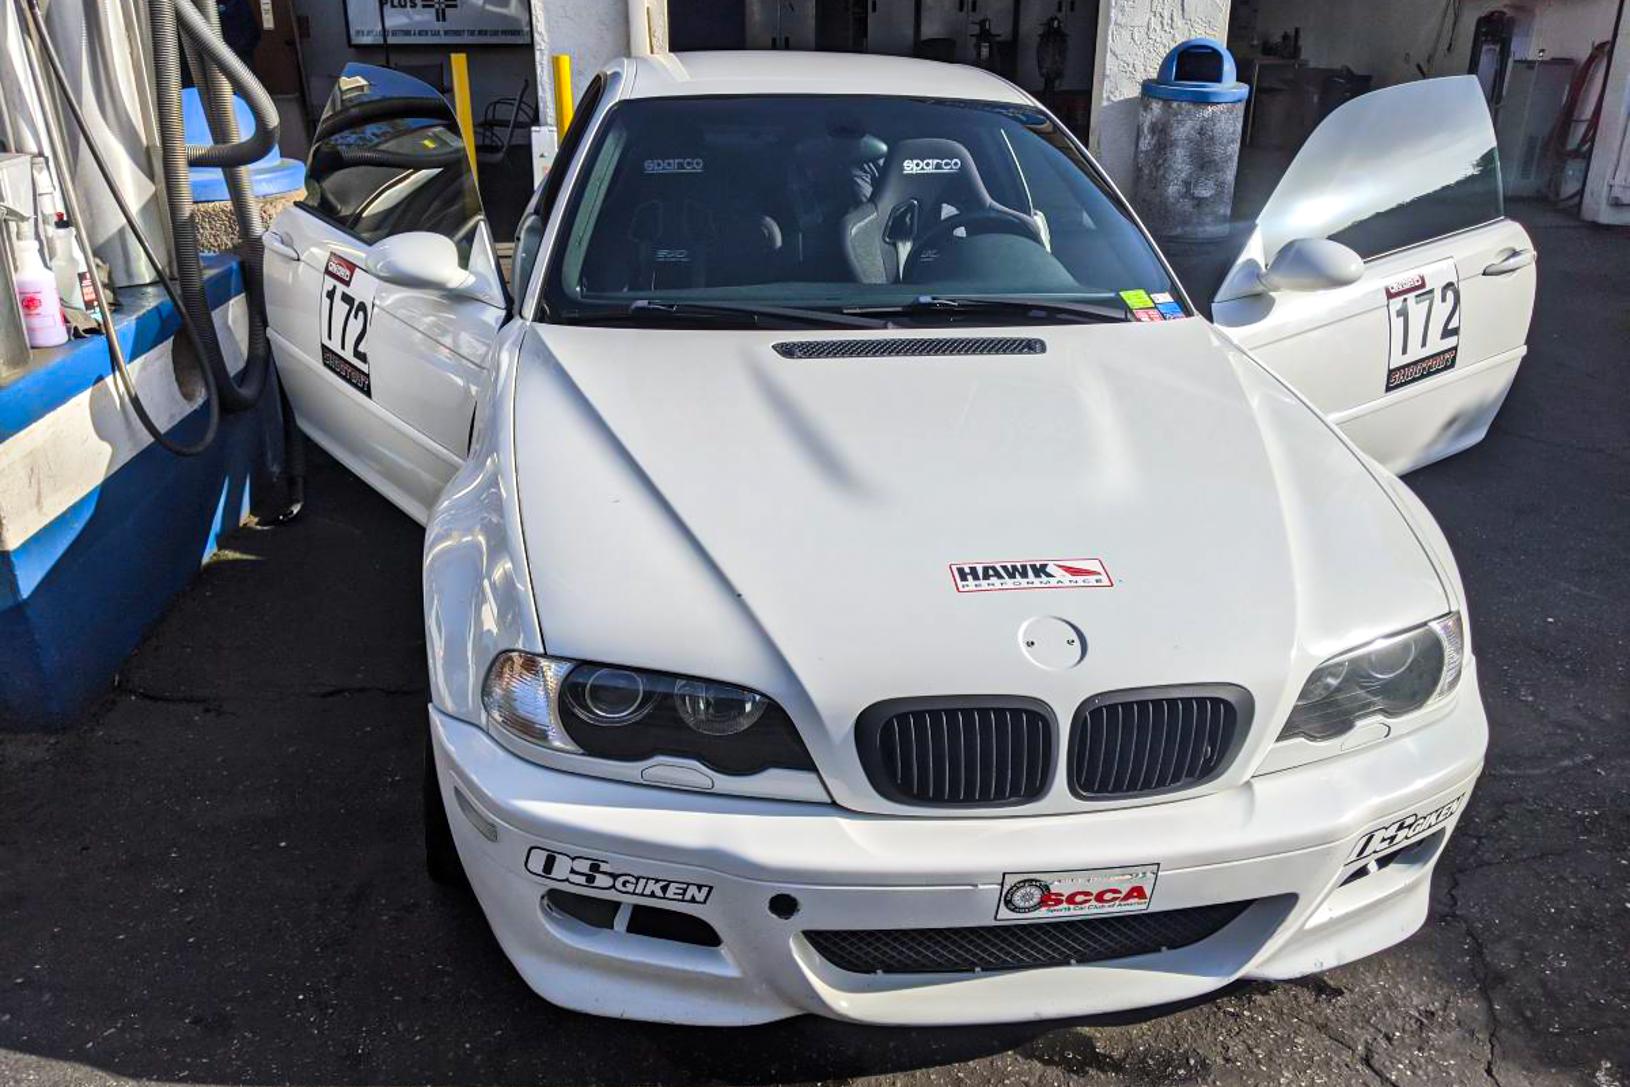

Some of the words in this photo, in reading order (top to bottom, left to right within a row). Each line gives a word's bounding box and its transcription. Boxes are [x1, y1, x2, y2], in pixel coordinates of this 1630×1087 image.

[644, 158, 704, 173] sparco
[903, 158, 961, 174] sparco
[326, 285, 368, 363] 172
[1396, 281, 1460, 355] 172
[1389, 351, 1456, 386] SHOOTOUT
[956, 563, 1056, 582] HAWK
[961, 577, 1103, 589] PERFORMANCE
[1041, 886, 1148, 908] SCCA
